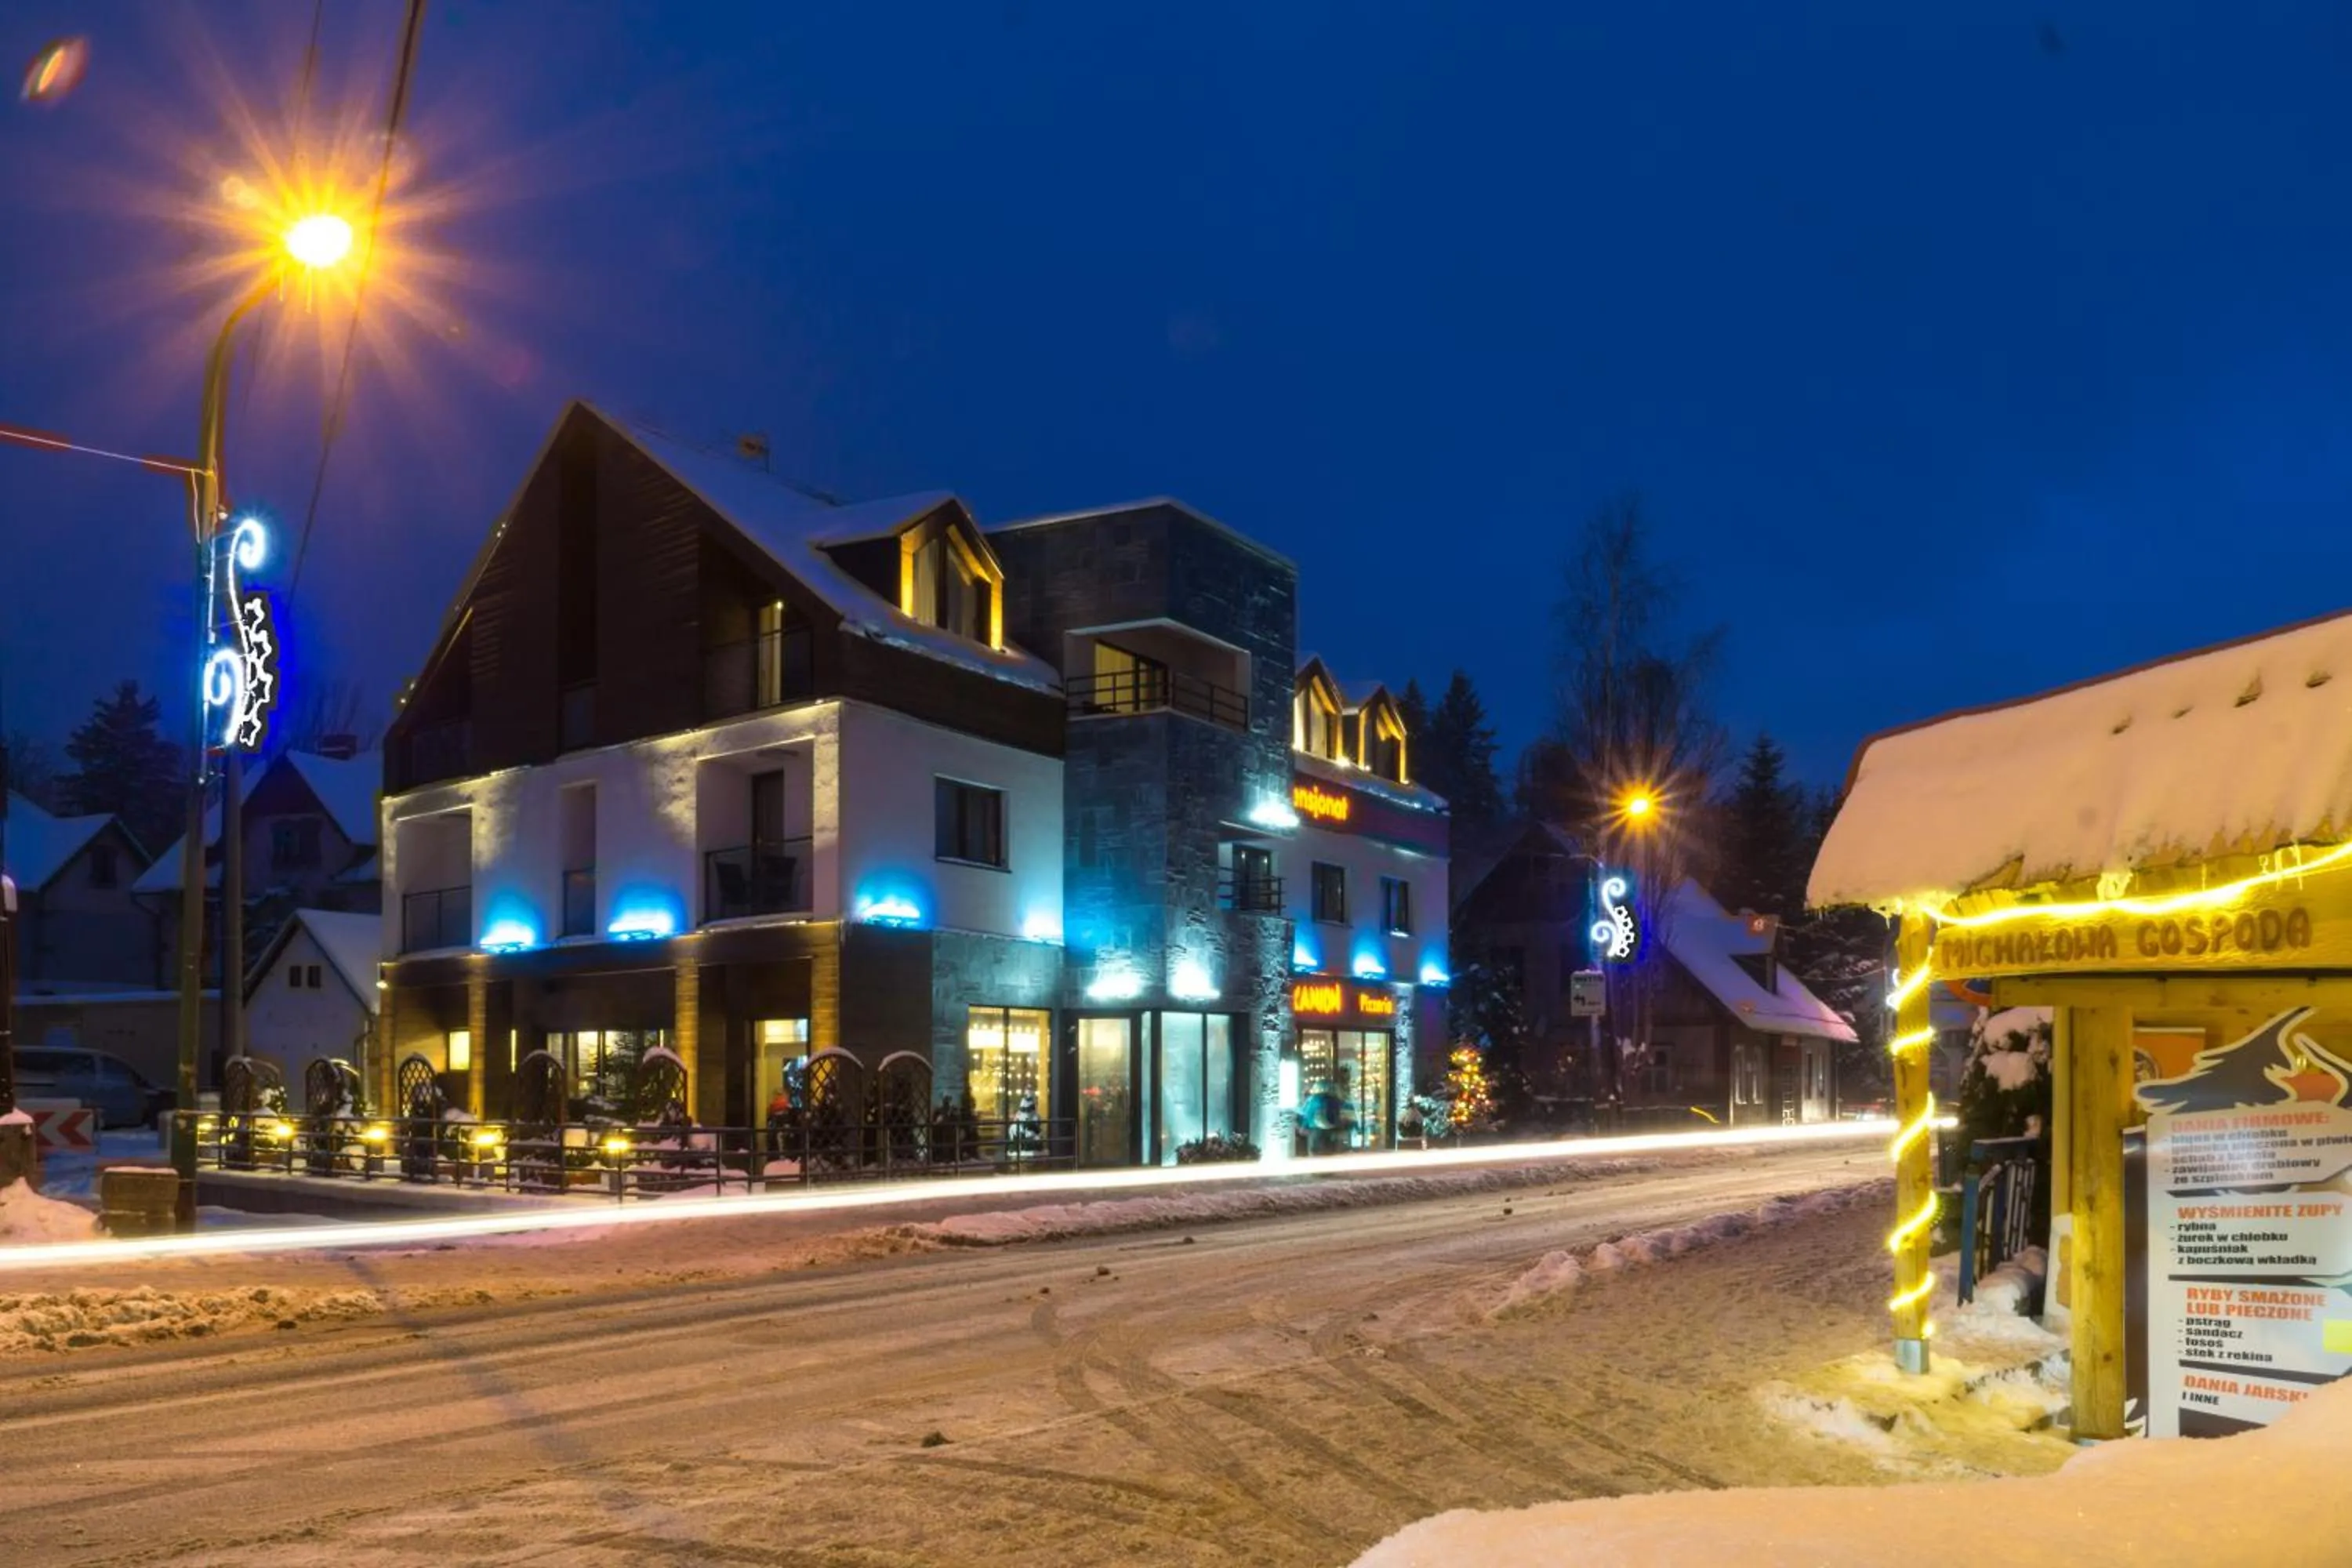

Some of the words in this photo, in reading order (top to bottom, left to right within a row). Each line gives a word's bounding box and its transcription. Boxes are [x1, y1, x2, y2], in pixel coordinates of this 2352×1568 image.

[1294, 785, 1348, 821] ensjonat
[2136, 906, 2312, 958] GOSPODA
[2171, 1118, 2228, 1132] DANIA
[2234, 1112, 2329, 1129] FIRMOWE:
[2252, 1158, 2321, 1171] drobiowy
[2173, 1176, 2188, 1185] ze
[2177, 1203, 2292, 1219] WYŚMIENITE
[2297, 1203, 2343, 1217] ZUPY
[2177, 1221, 2217, 1232] rybna
[2177, 1232, 2214, 1243] żurek
[2216, 1233, 2228, 1242] w
[2230, 1231, 2288, 1242] chlebku
[2177, 1243, 2249, 1254] kapuśniak
[2187, 1255, 2254, 1266] boczkową
[2257, 1254, 2318, 1265] wkładką
[2186, 1287, 2234, 1301] RYBY
[2238, 1290, 2327, 1307] SMAŻONE
[2186, 1302, 2220, 1316] LUB
[2226, 1305, 2314, 1321] PIECZONE
[2185, 1327, 2244, 1339] sandacz
[2185, 1348, 2216, 1358] stek
[2227, 1350, 2273, 1362] rekina
[2183, 1374, 2239, 1395] DANIA
[2189, 1392, 2220, 1406] INNE
